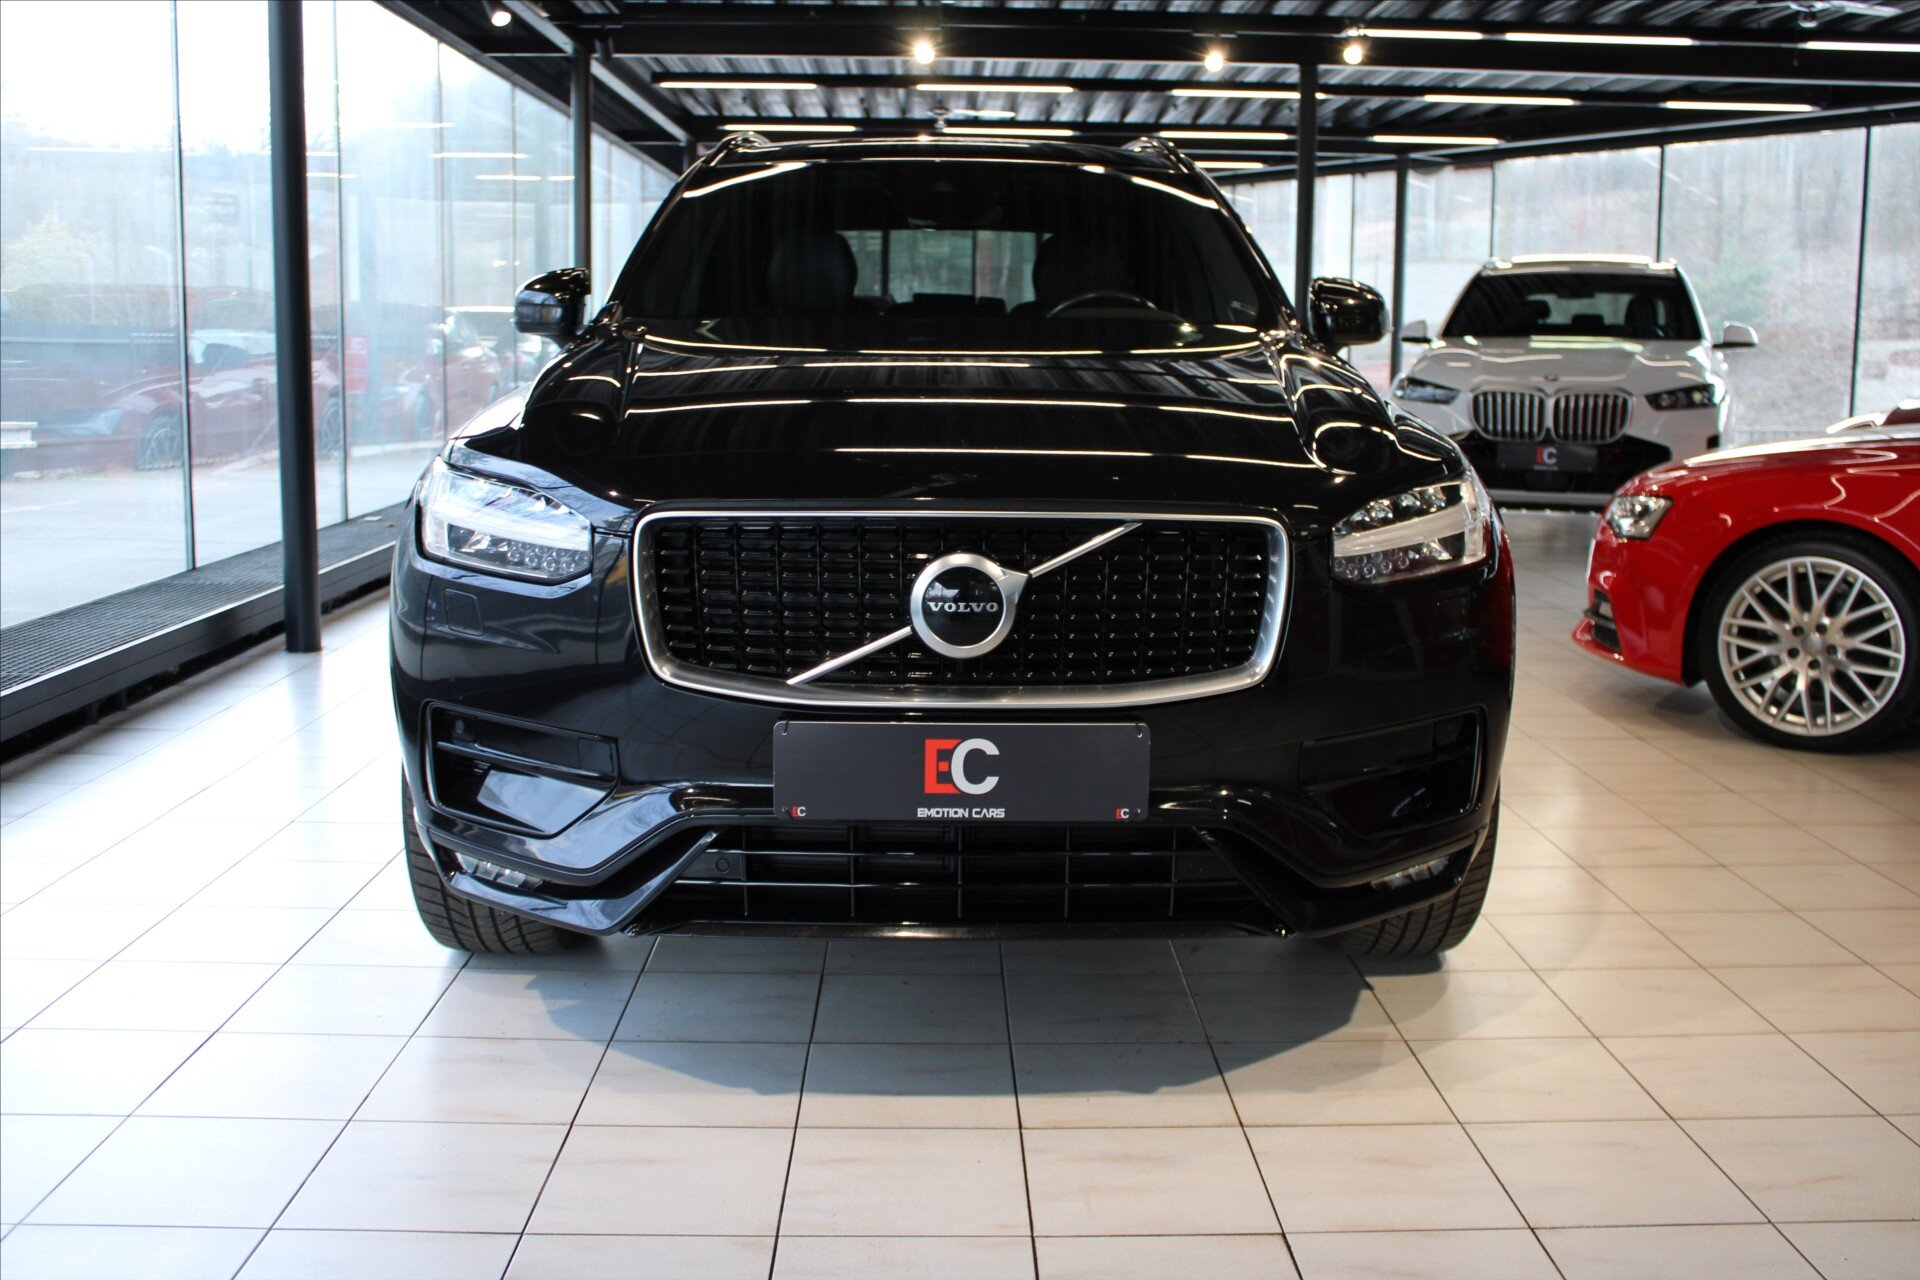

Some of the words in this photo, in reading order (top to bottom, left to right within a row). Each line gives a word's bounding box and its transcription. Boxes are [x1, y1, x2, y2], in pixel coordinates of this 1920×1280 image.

[927, 601, 999, 612] VOLVO
[925, 738, 999, 794] EC
[917, 807, 969, 818] EMOTION
[972, 808, 1005, 819] CARS
